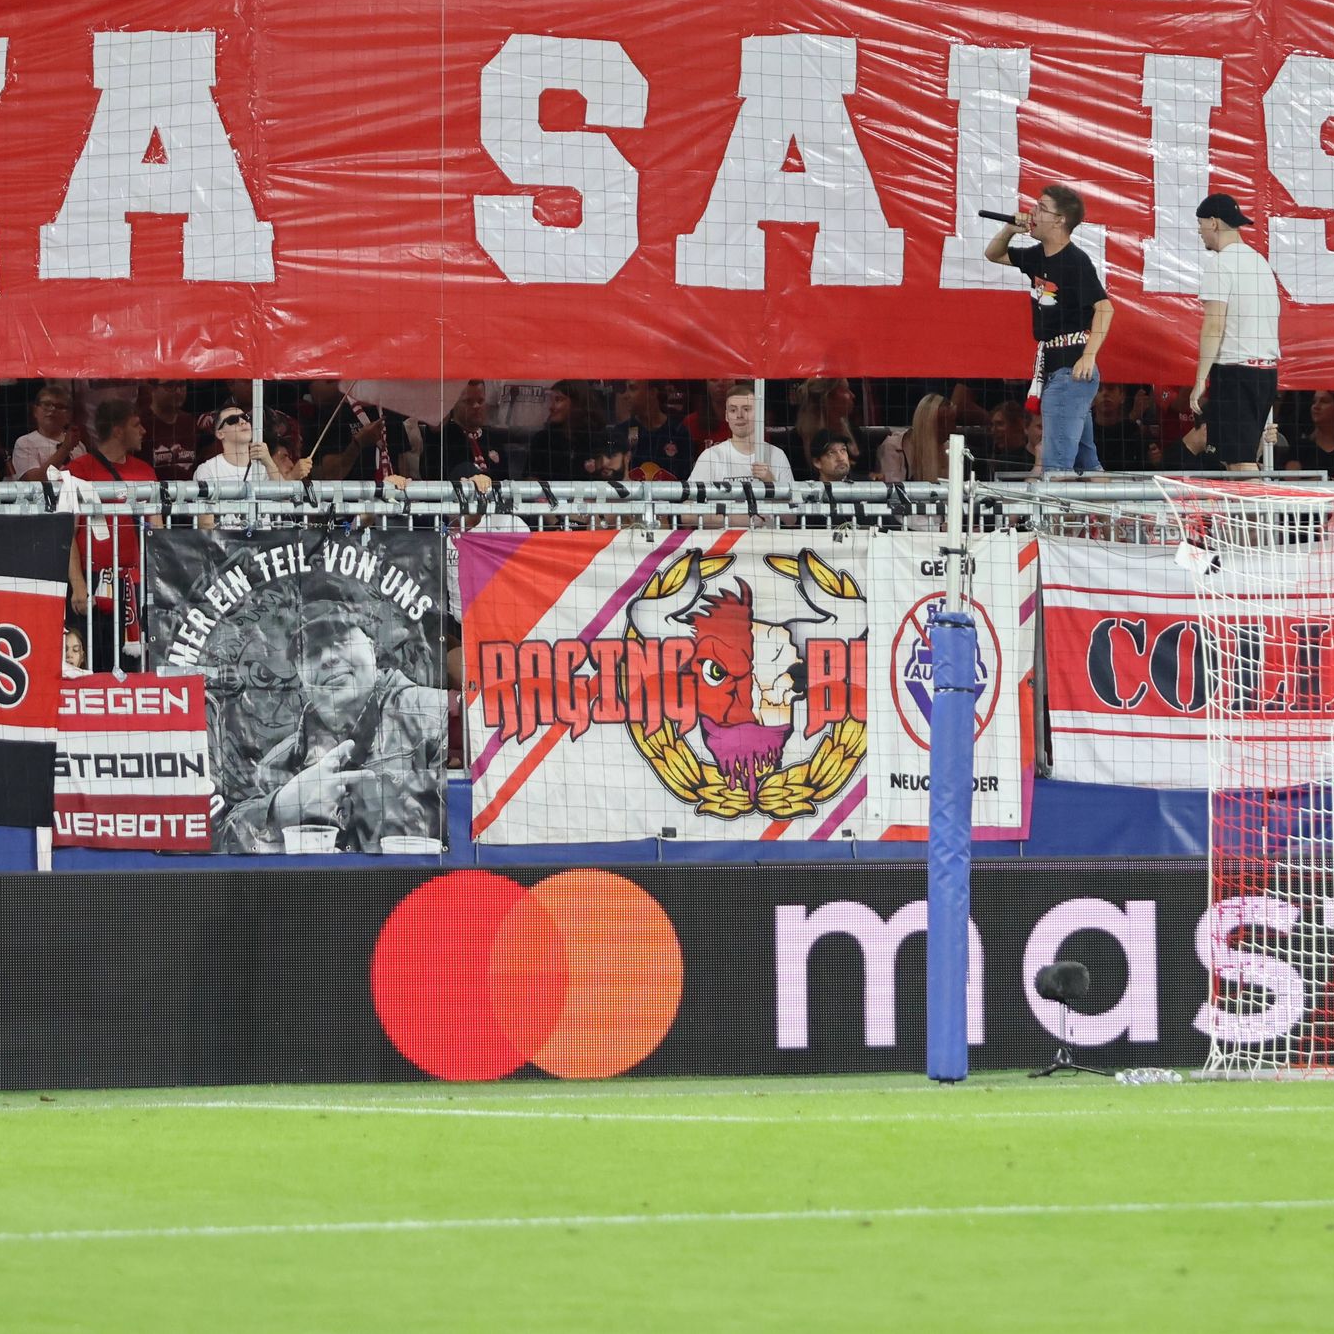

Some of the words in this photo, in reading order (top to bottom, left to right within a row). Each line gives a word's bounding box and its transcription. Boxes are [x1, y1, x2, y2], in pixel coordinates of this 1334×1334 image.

[204, 565, 252, 614] EIN
[253, 542, 312, 582] TEIL
[322, 541, 378, 583] VON
[380, 565, 433, 621] UNS
[478, 637, 699, 744] RAGING
[55, 752, 204, 778] STADION
